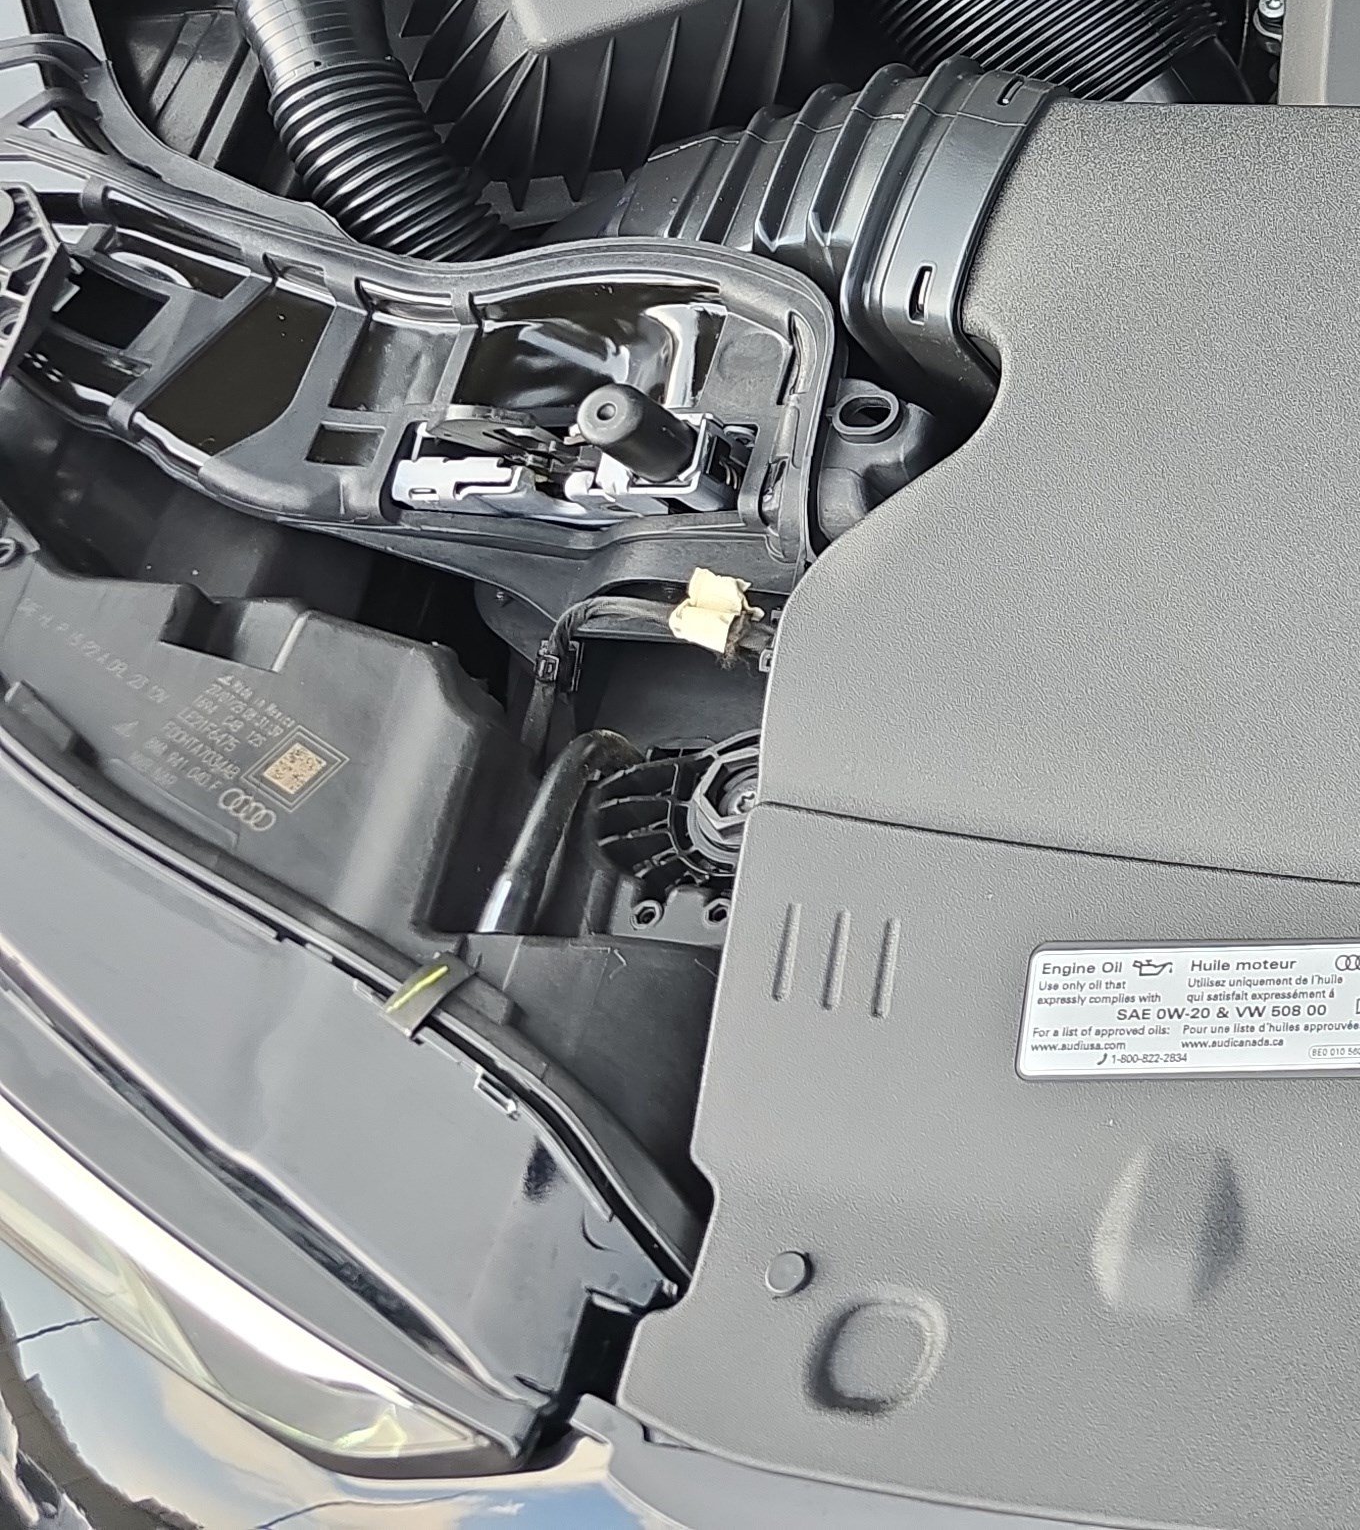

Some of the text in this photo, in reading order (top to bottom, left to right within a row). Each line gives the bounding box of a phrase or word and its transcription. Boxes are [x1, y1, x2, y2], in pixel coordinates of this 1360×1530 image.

[1041, 961, 1122, 976] Engine Oil
[1190, 959, 1297, 971] Huile moteur
[1038, 980, 1126, 991] Use only oil that
[1187, 977, 1226, 987] Utilisez
[1228, 977, 1292, 987] uniquement
[1294, 975, 1308, 985] de
[1037, 993, 1161, 1006] expressly complies with
[1186, 992, 1204, 1003] qui
[1206, 991, 1248, 1001] satisfait
[1116, 1008, 1151, 1020] SAE
[1216, 1006, 1229, 1018] &
[1235, 1005, 1266, 1017] VW
[1271, 1004, 1301, 1017] 508
[1306, 1004, 1326, 1016] 00
[1032, 1027, 1050, 1037] For
[1052, 1029, 1059, 1037] a
[1061, 1027, 1078, 1036] list
[1080, 1026, 1092, 1036] of
[1094, 1025, 1145, 1037] approved
[1182, 1024, 1207, 1034] Pour
[1210, 1025, 1230, 1033] une
[1233, 1023, 1255, 1032] liste
[1030, 1041, 1125, 1051] www.audiusa.com
[1181, 1037, 1283, 1048] www.audicanada.ca
